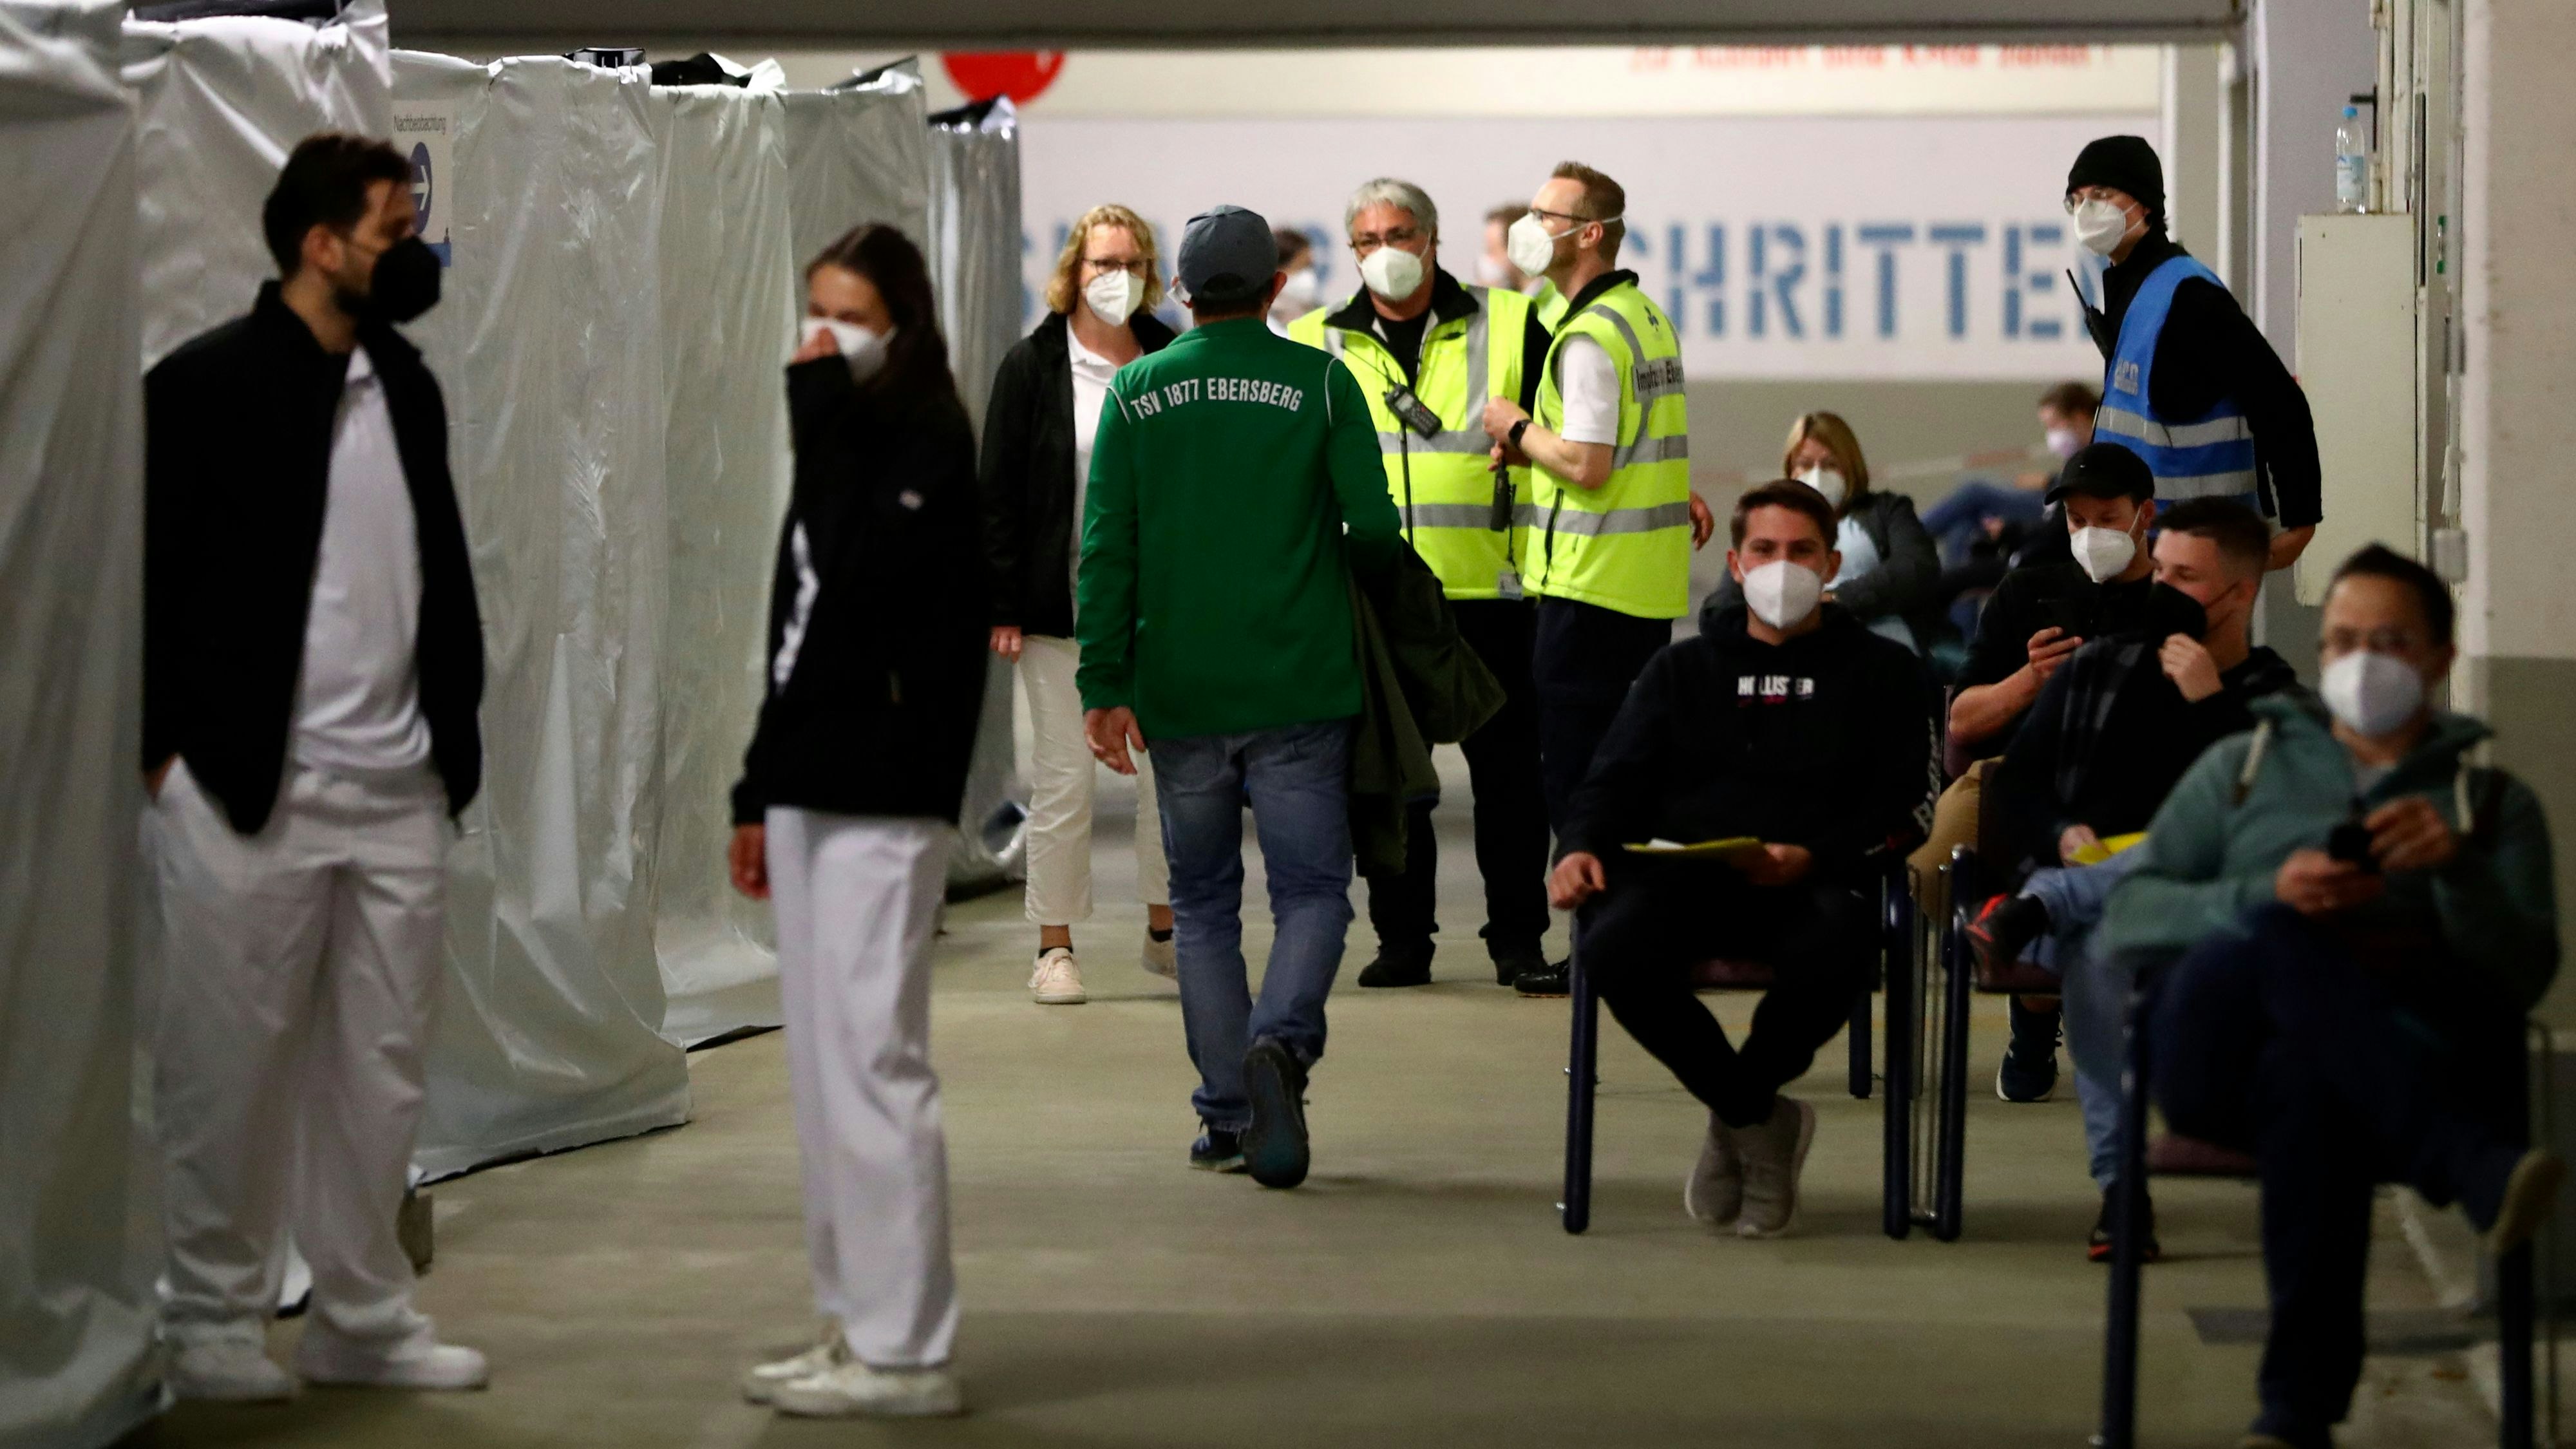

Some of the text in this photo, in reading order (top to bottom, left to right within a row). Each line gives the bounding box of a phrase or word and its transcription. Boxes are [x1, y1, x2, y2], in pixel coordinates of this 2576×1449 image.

[1130, 377, 1303, 419] TSV 1877 EBERSBERG
